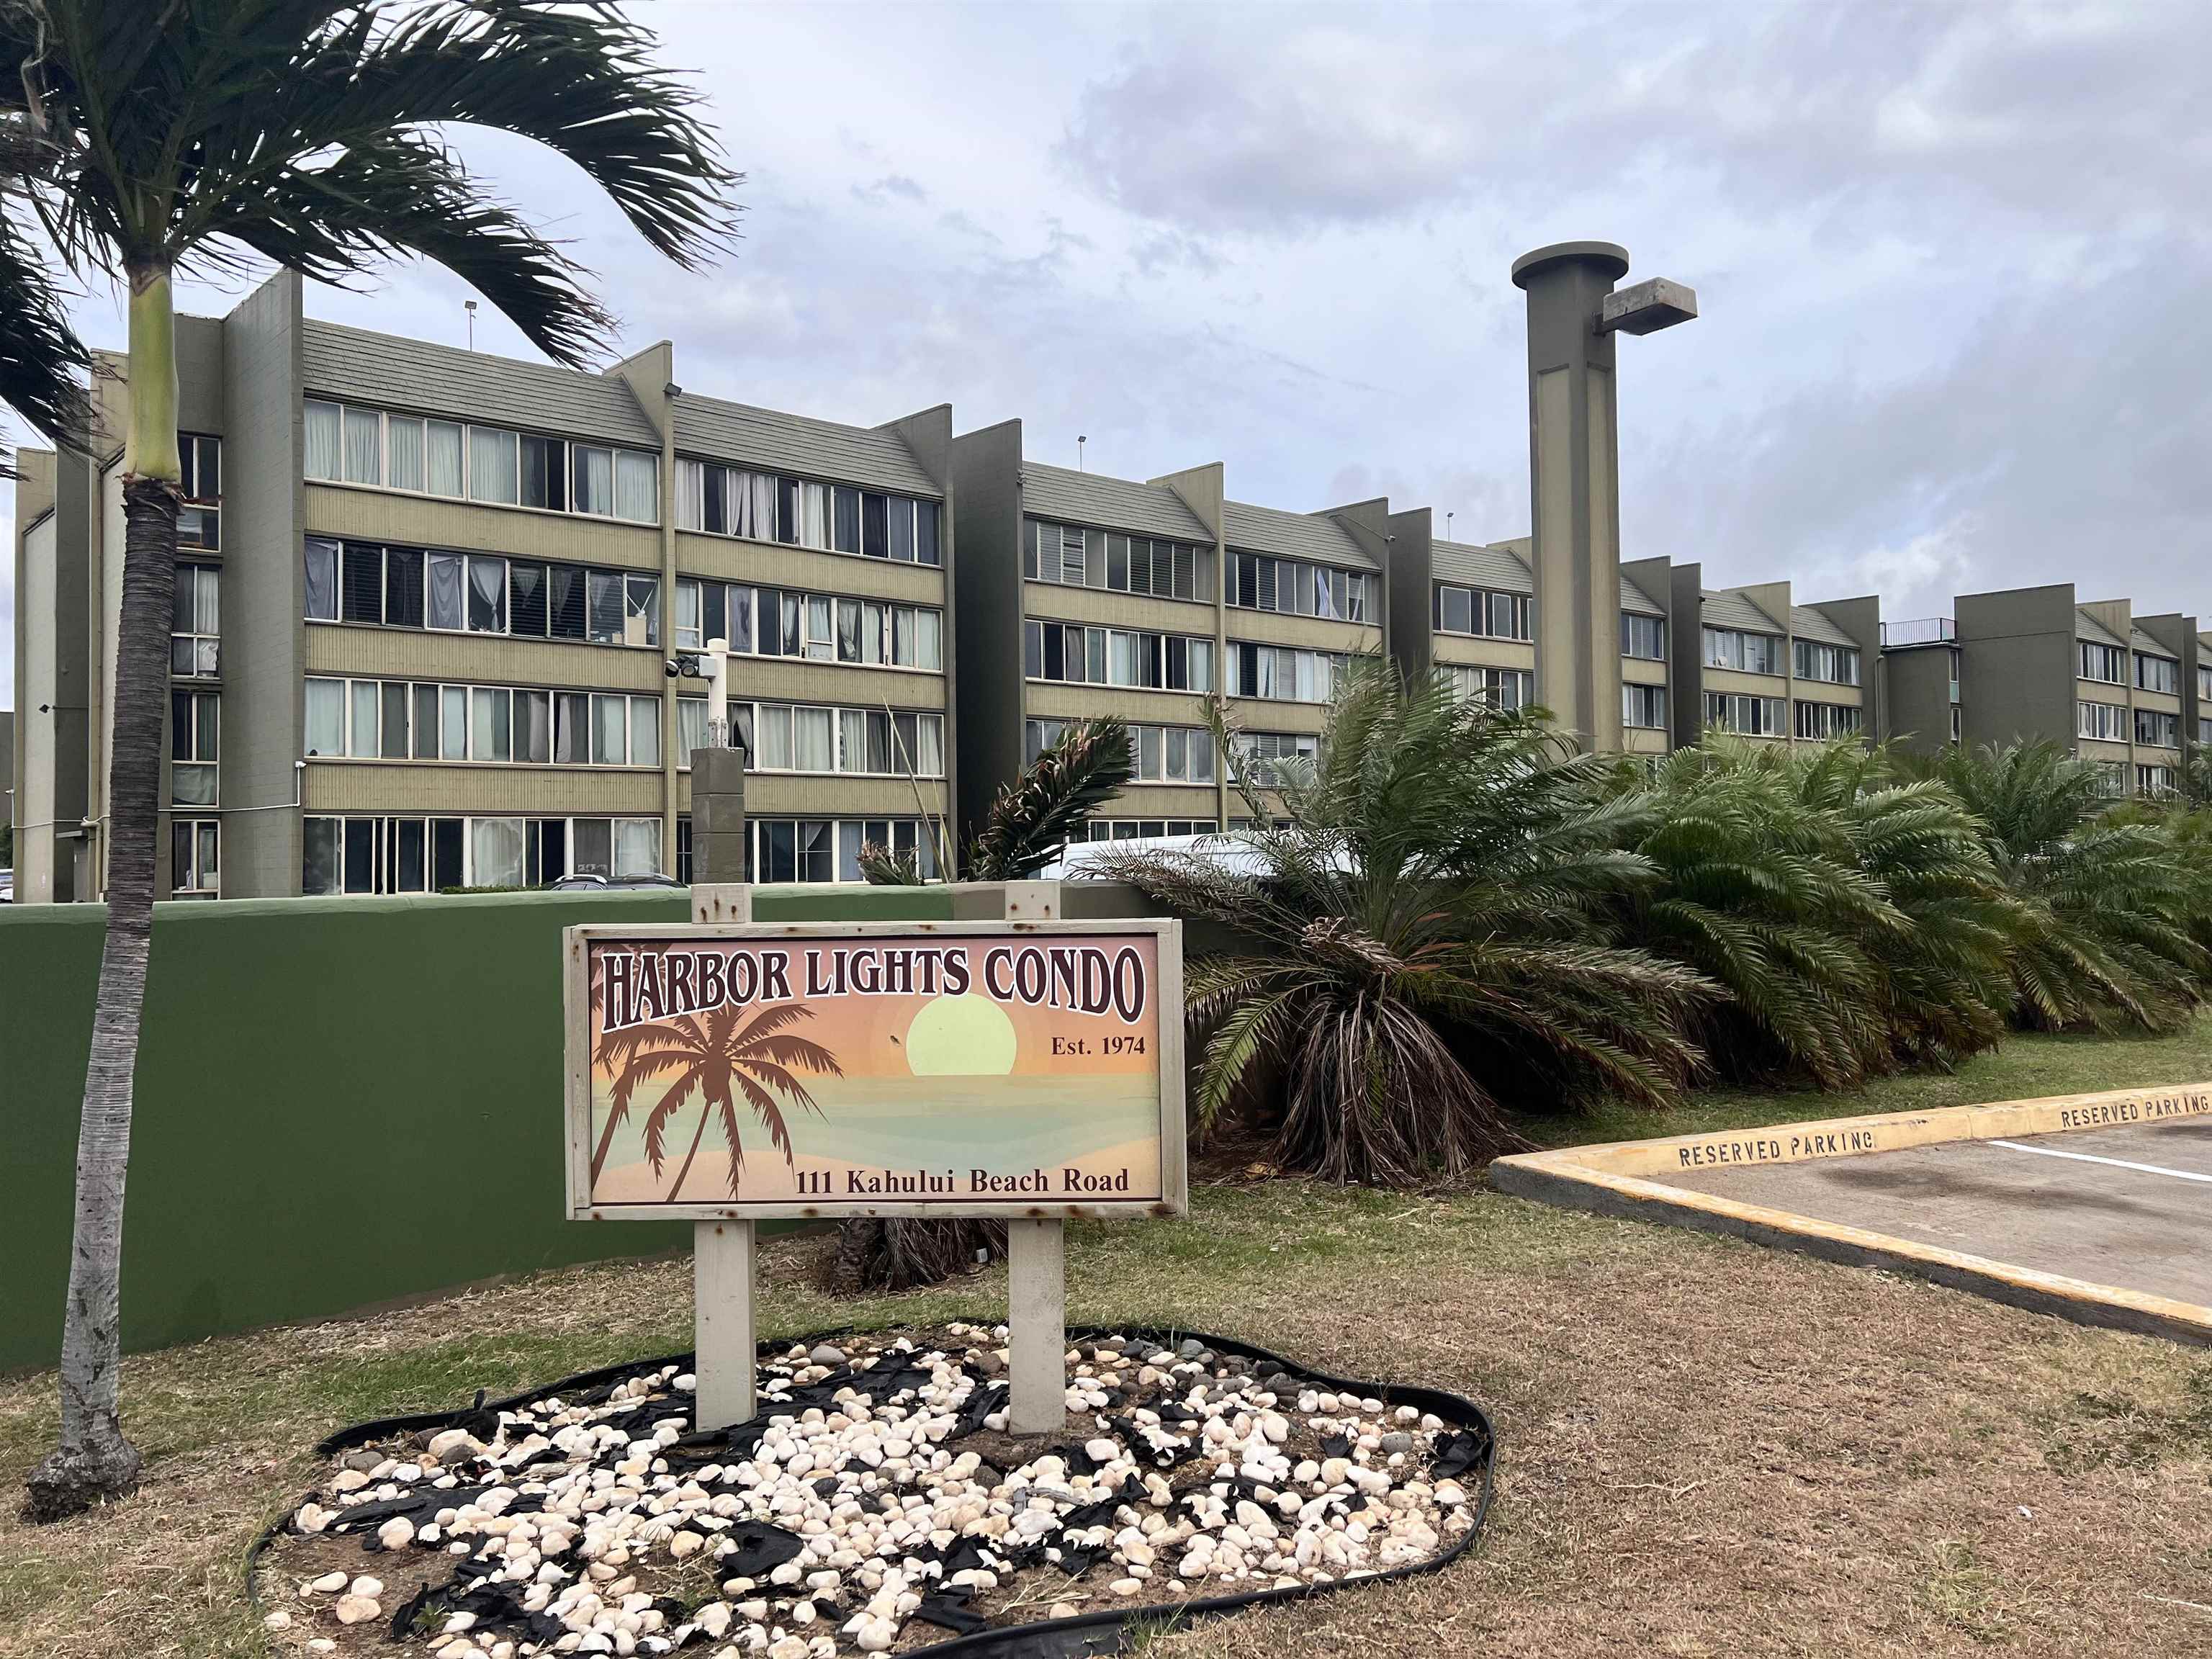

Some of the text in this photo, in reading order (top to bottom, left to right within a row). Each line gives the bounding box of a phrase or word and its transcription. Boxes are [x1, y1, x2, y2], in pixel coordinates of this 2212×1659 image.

[602, 945, 1146, 1033] HARBOR LIGHTS CONDO
[1051, 1037, 1146, 1055] Est. 1974
[2062, 1096, 2208, 1128] RESERVED PARKING
[1679, 1131, 1872, 1166] RESERVED PARKING
[796, 1168, 1130, 1194] 111 Kahului Beach Road
